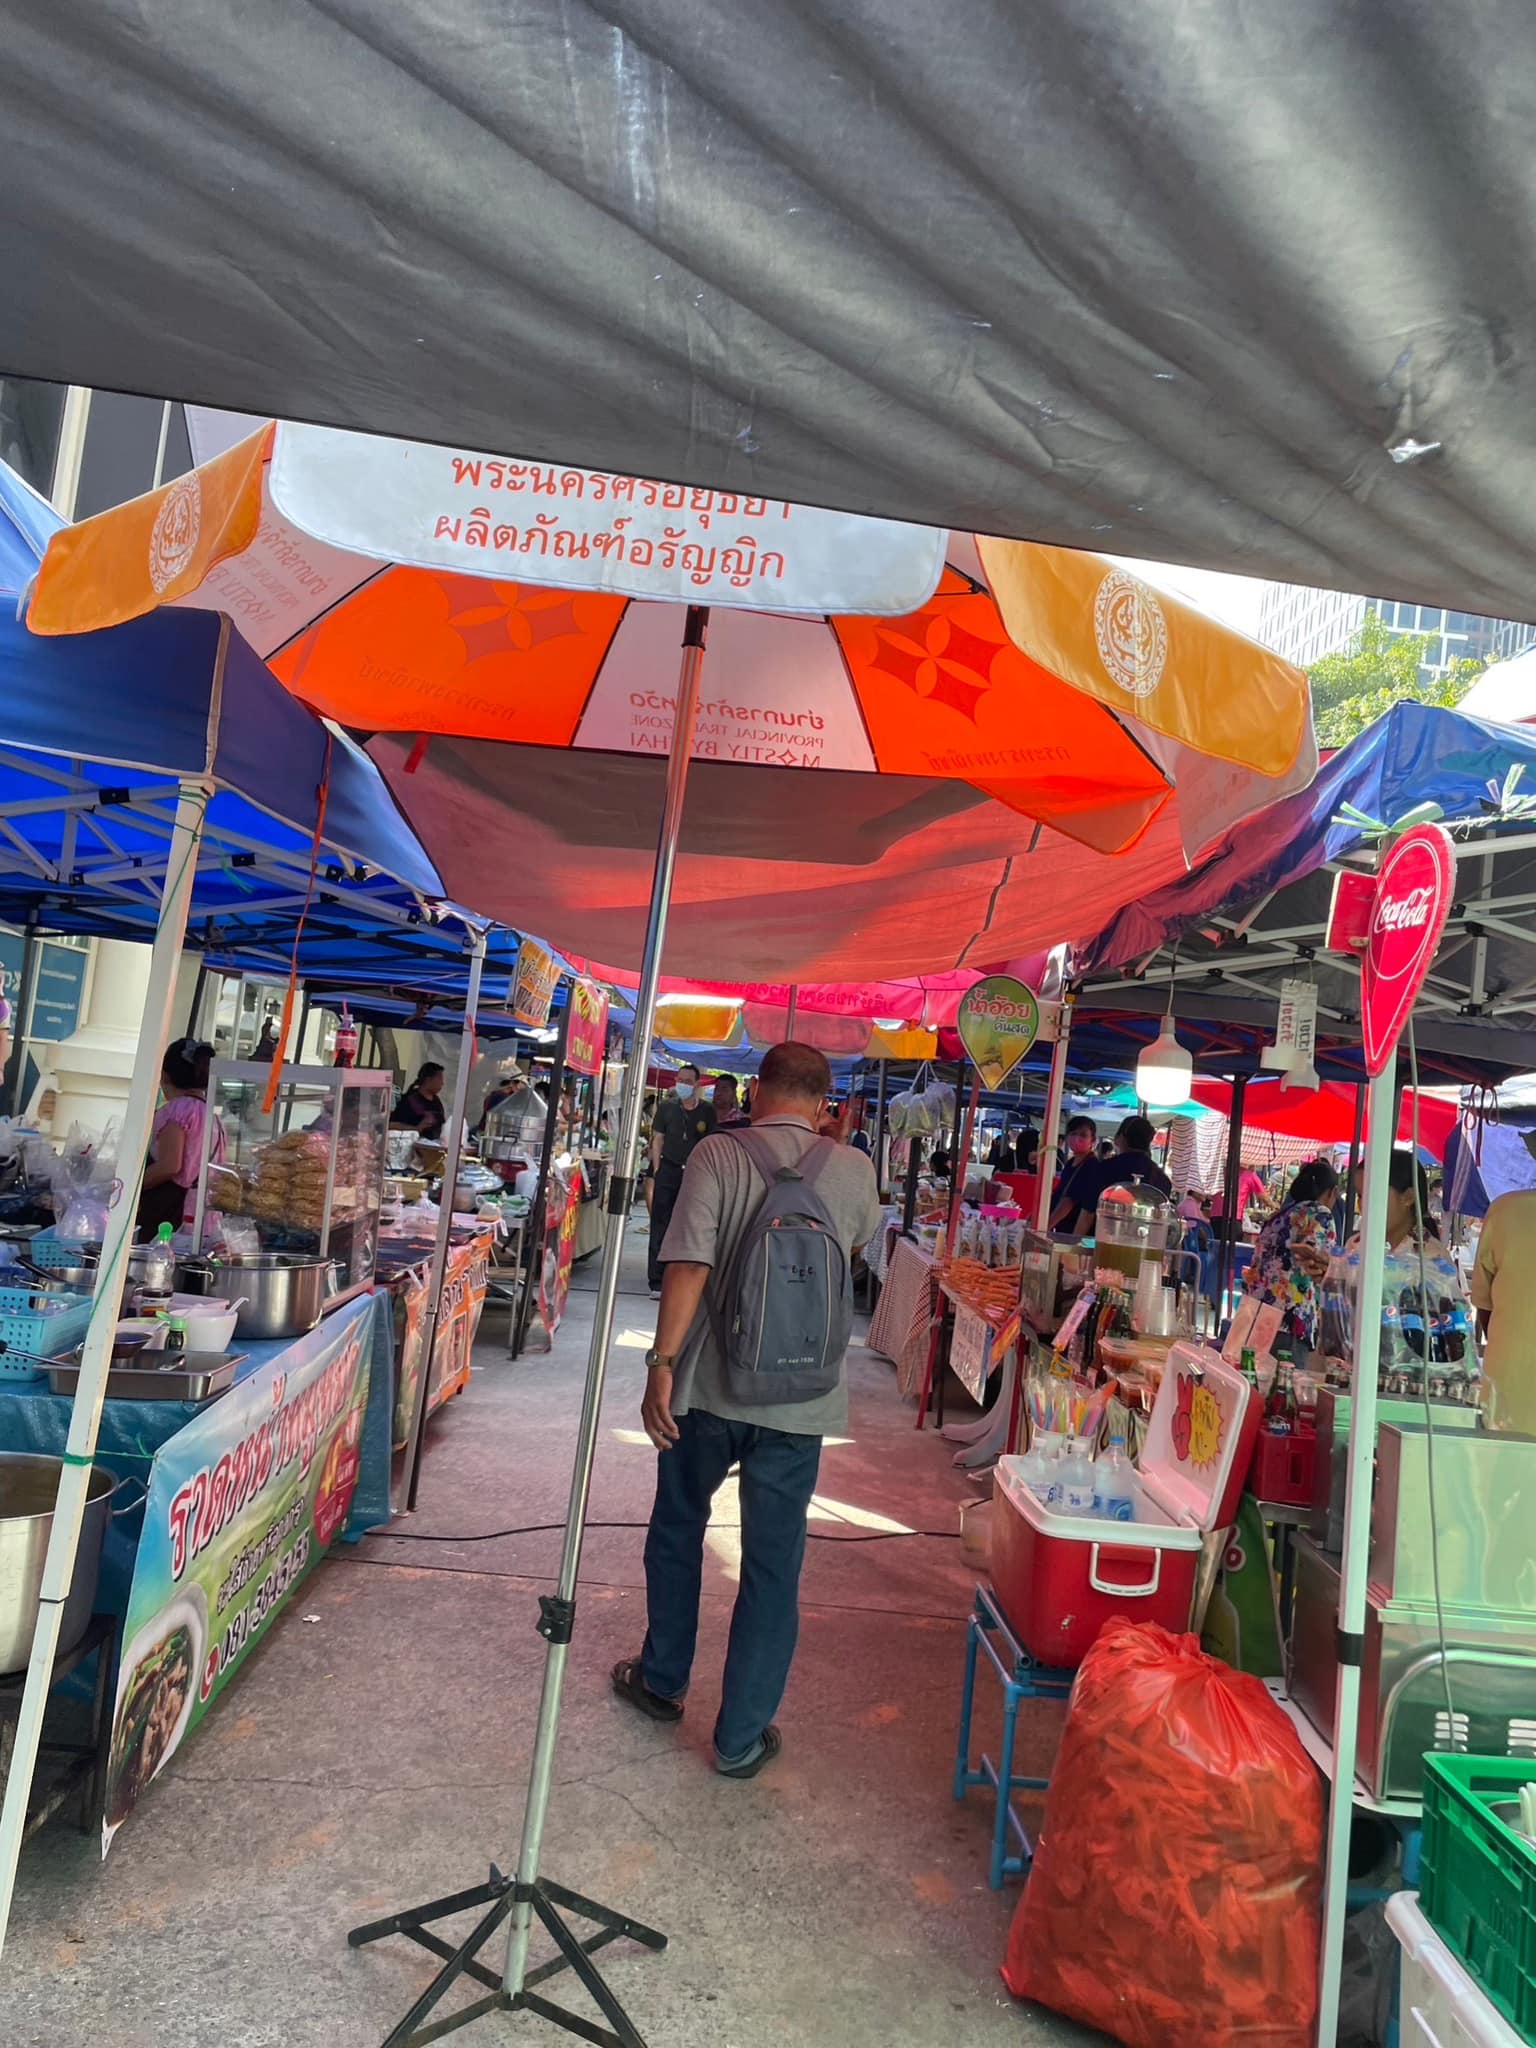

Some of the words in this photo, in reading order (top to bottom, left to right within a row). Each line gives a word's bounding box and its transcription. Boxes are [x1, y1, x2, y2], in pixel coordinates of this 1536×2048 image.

[434, 507, 785, 587] ผลิตภัณฑ์อรัญญิก
[1374, 885, 1435, 934] Coca-Cola
[967, 988, 1032, 1020] น้ำอ้อย
